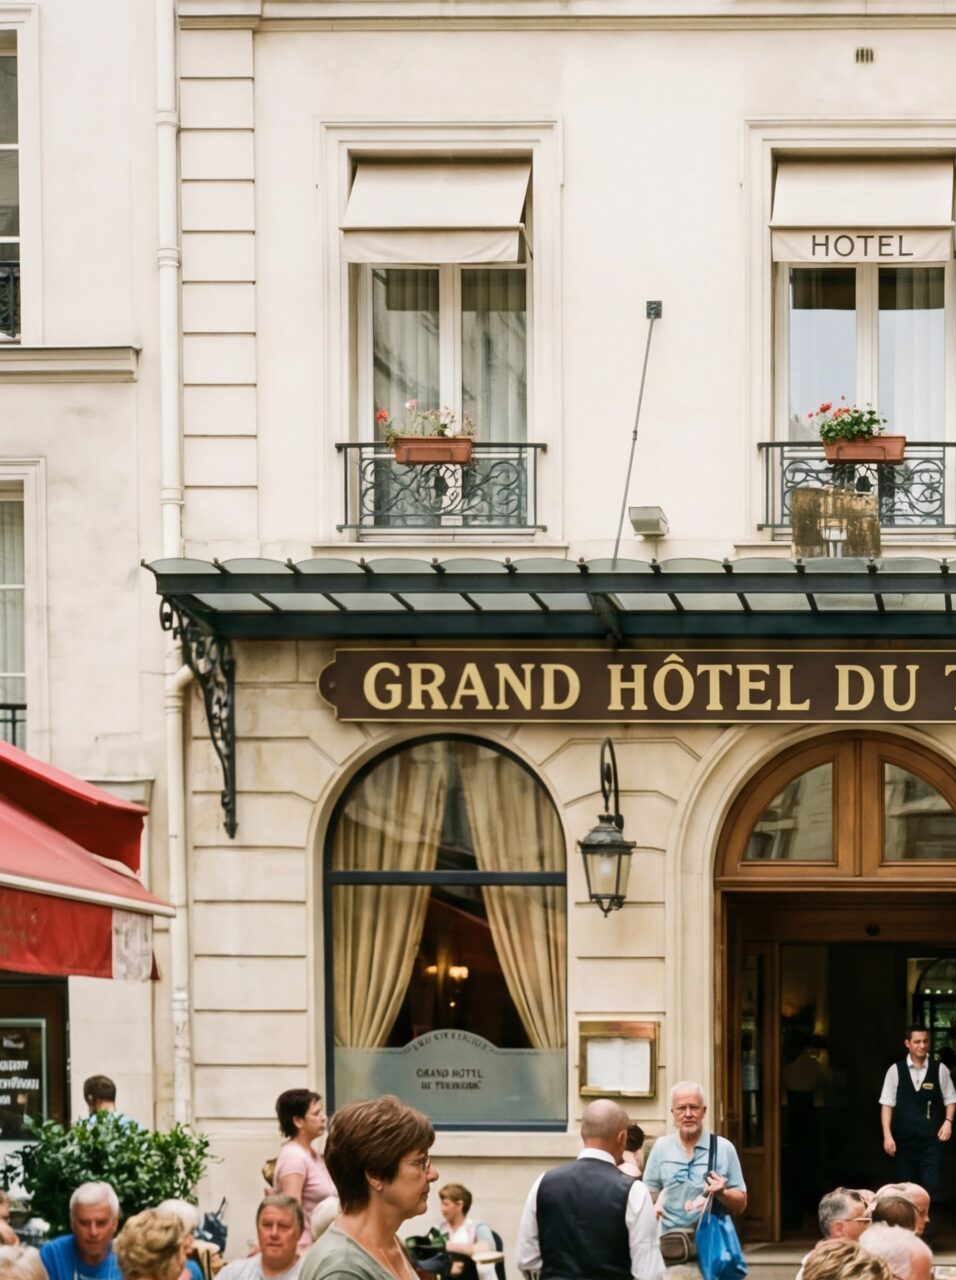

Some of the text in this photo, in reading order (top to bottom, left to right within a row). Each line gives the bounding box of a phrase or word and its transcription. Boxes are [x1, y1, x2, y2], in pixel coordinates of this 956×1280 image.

[811, 234, 914, 257] HOTEL
[363, 662, 580, 711] GRAND
[608, 653, 810, 711] HÔTEL
[835, 664, 920, 712] DU
